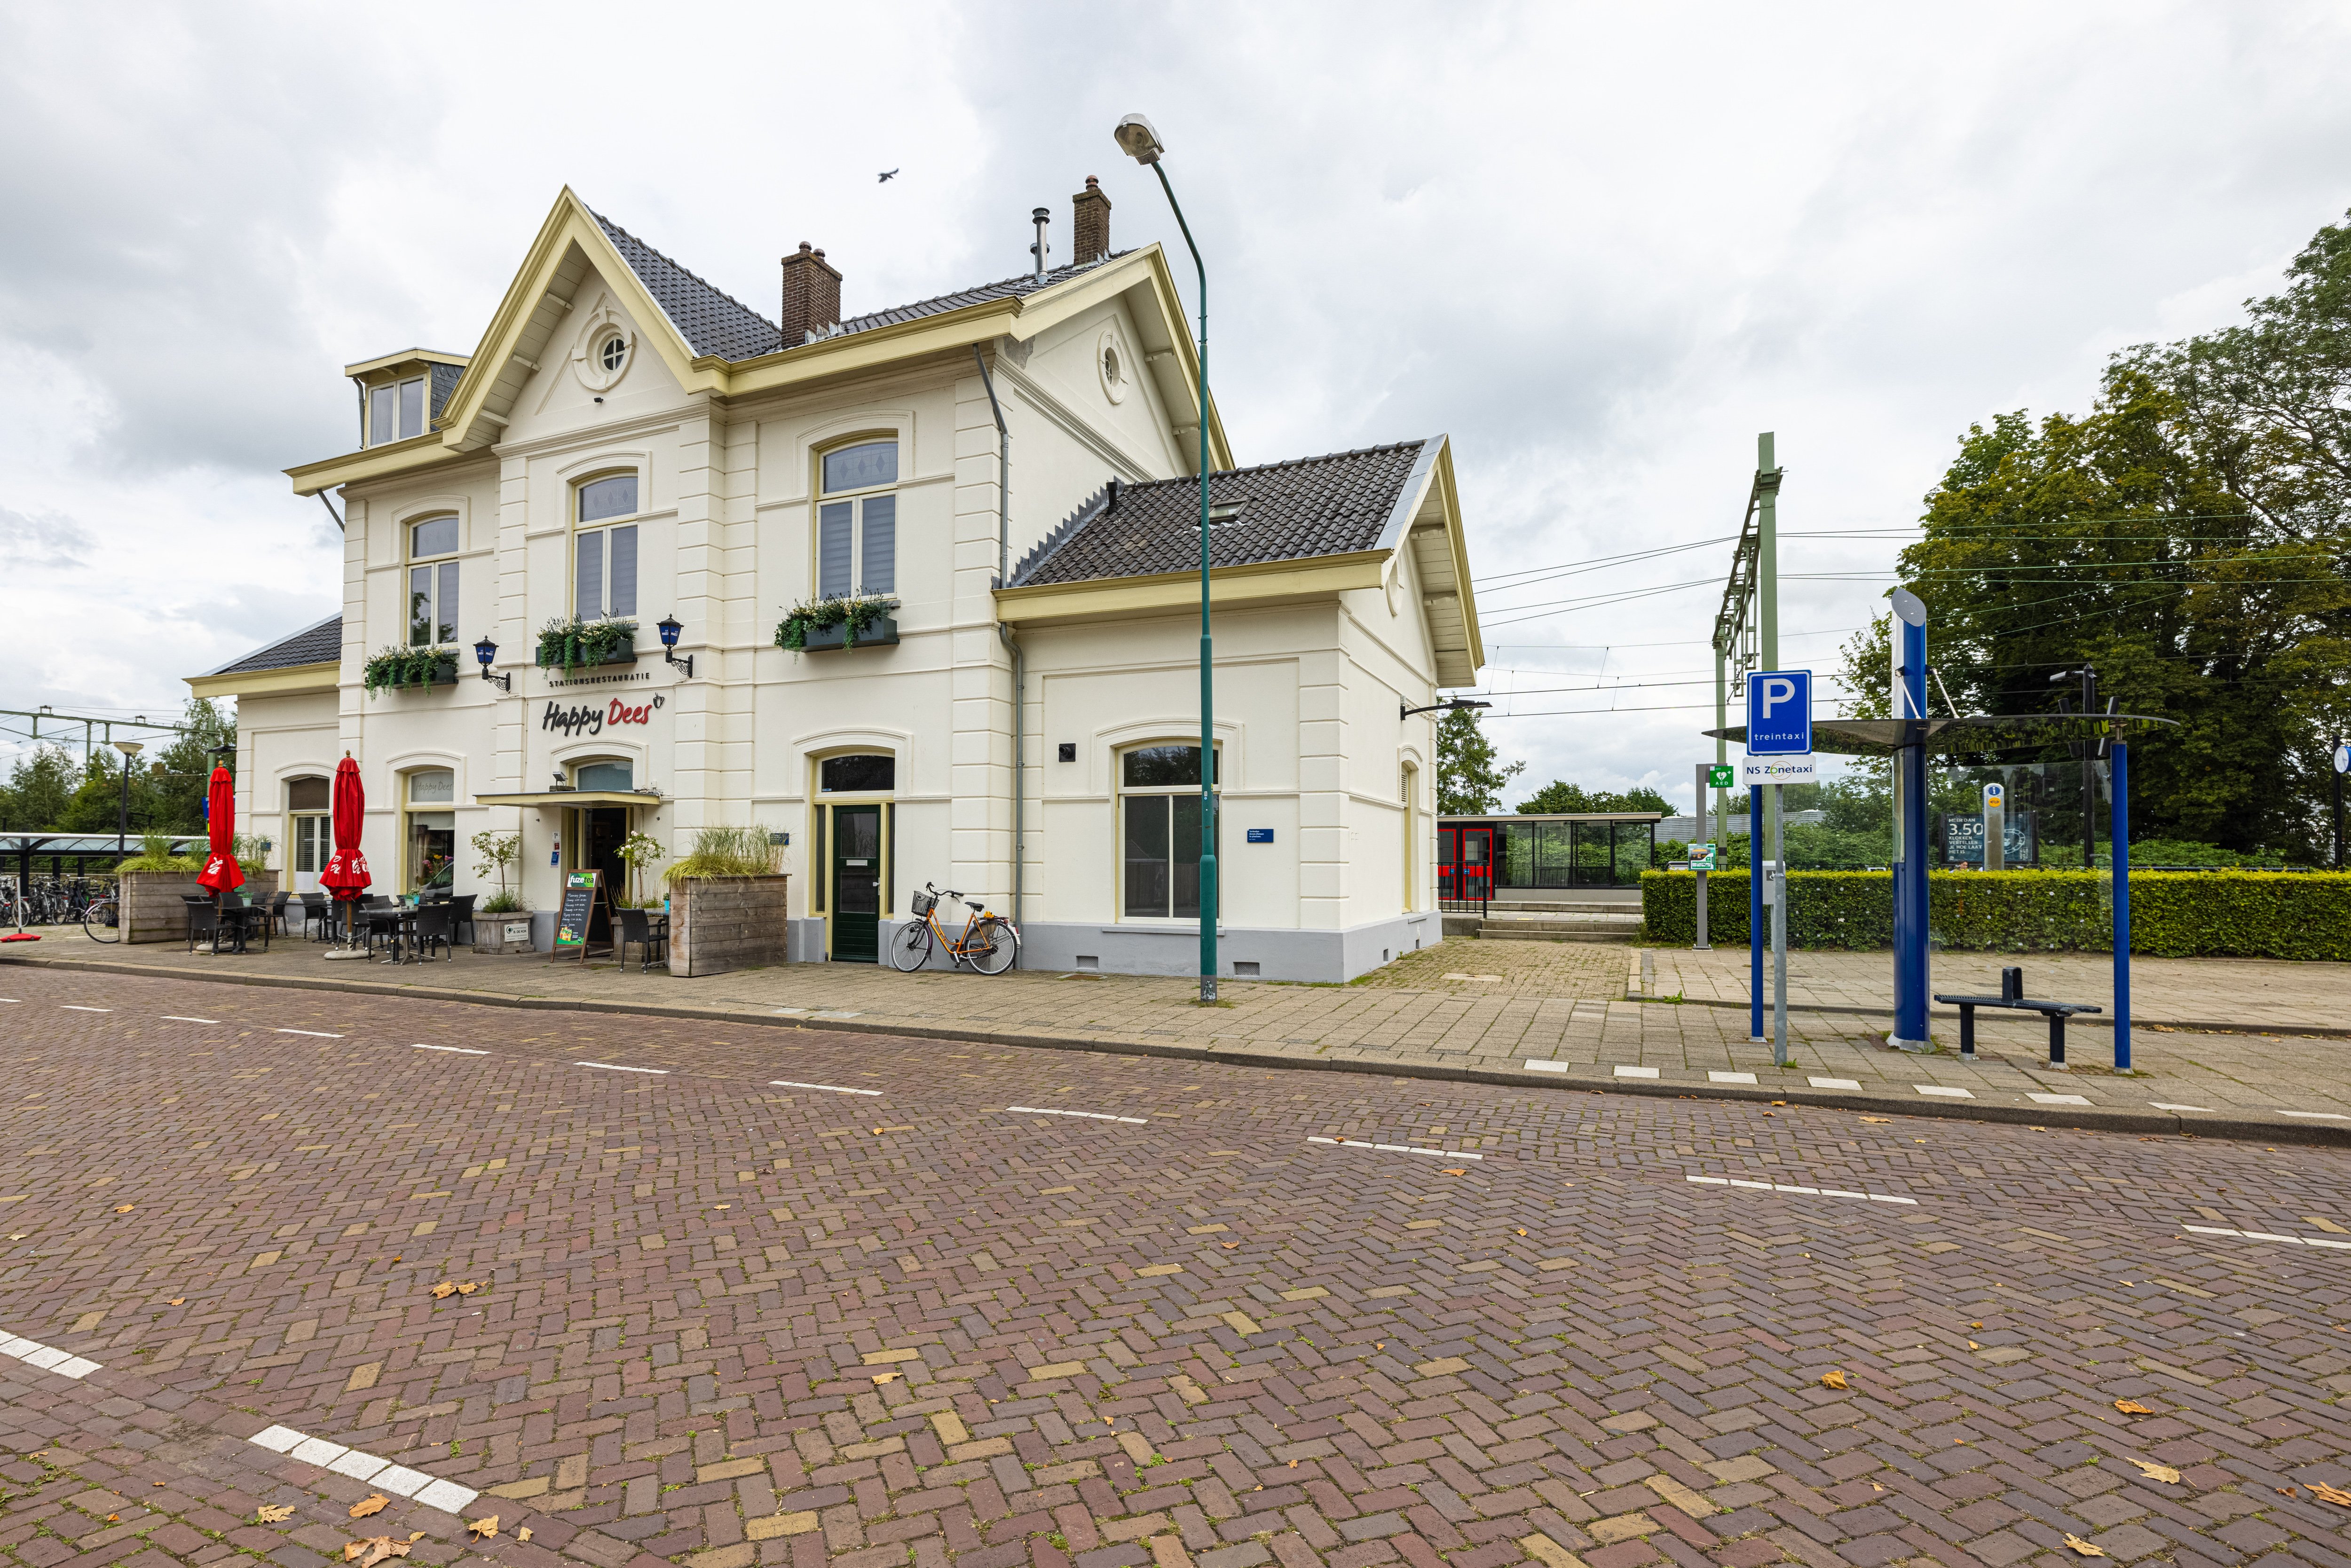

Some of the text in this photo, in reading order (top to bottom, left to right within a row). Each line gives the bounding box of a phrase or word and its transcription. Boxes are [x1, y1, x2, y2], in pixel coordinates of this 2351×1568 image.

[549, 673, 650, 688] STATIONSRESTAURATIE
[1763, 678, 1795, 719] P
[542, 697, 653, 737] Happy Dees
[1754, 732, 1804, 741] treintaxi
[1765, 764, 1812, 774] Zonetaxi
[416, 780, 452, 794] Happy Dees
